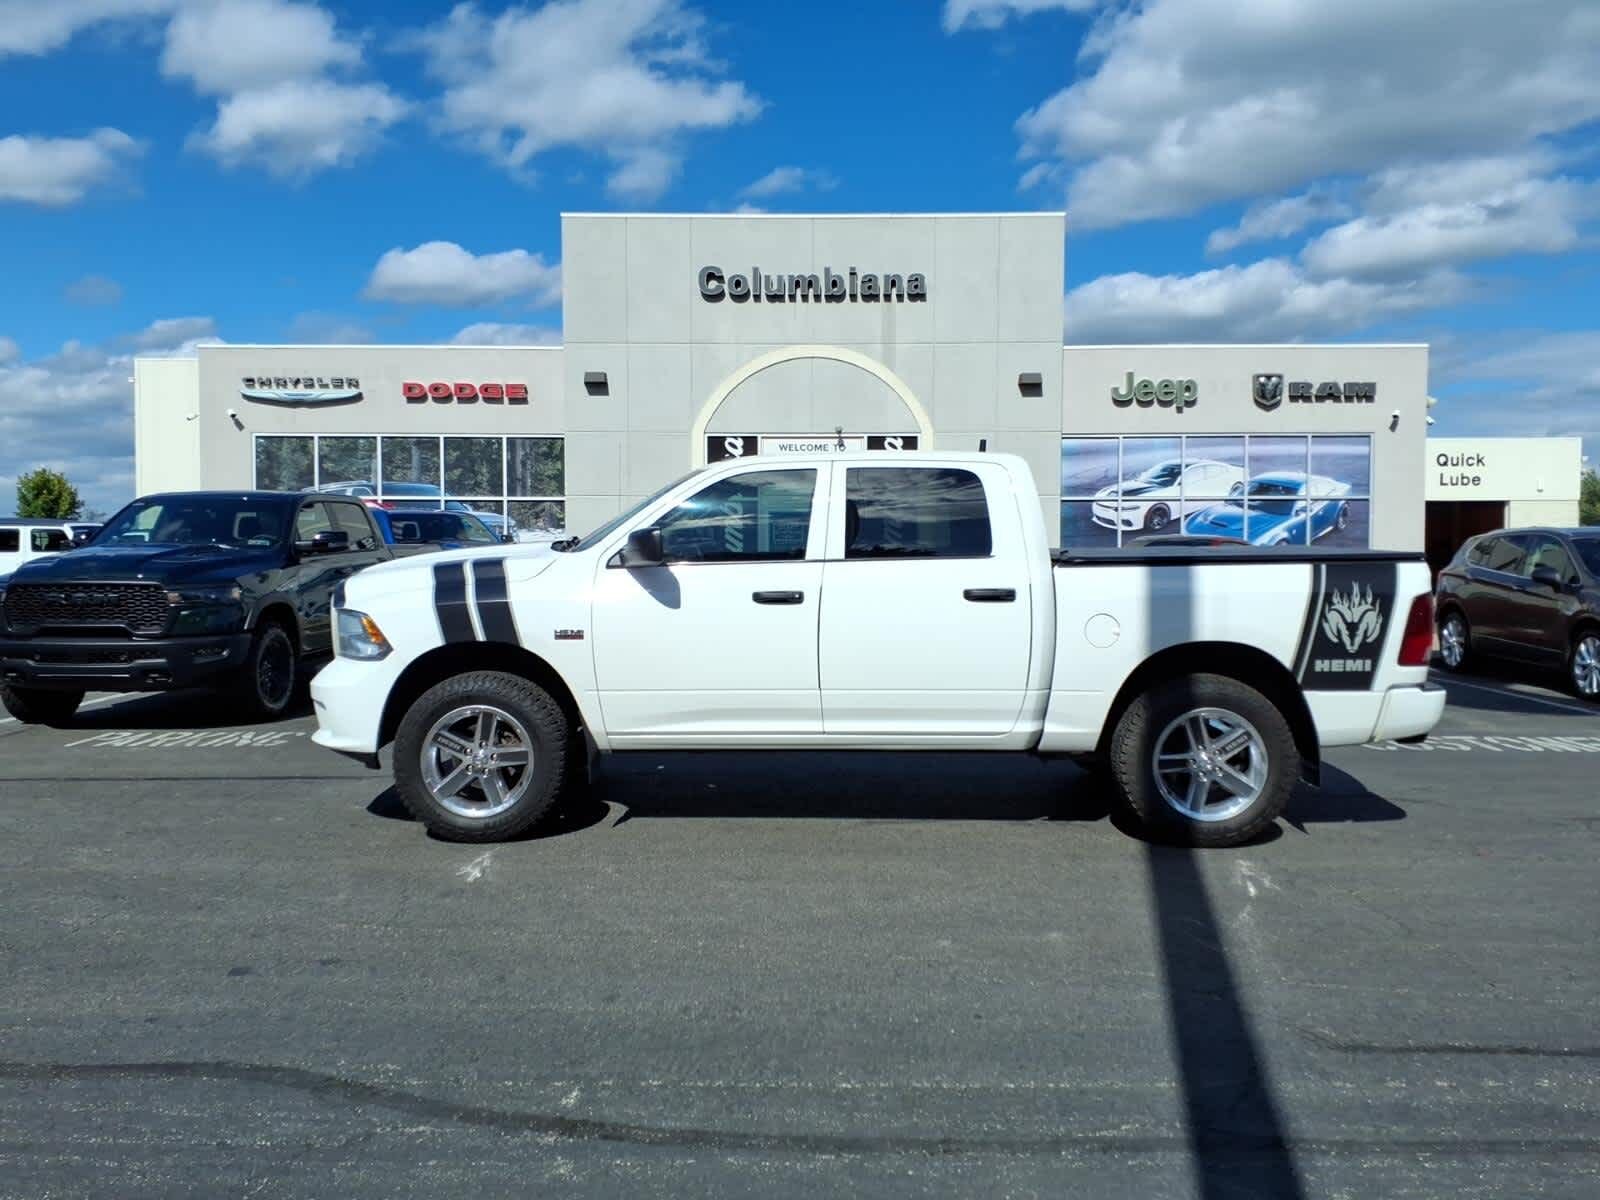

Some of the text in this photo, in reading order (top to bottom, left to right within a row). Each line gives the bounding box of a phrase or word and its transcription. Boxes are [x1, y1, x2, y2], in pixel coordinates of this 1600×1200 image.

[699, 266, 927, 302] Columbiana
[242, 377, 360, 389] CHRYSLER
[402, 383, 528, 404] DODGE
[1111, 371, 1198, 413] Jeep
[1288, 382, 1376, 403] RAM
[1436, 453, 1485, 467] Quick
[1440, 472, 1481, 486] Lube
[1314, 659, 1372, 672] HEMI
[64, 731, 306, 747] PARKING
